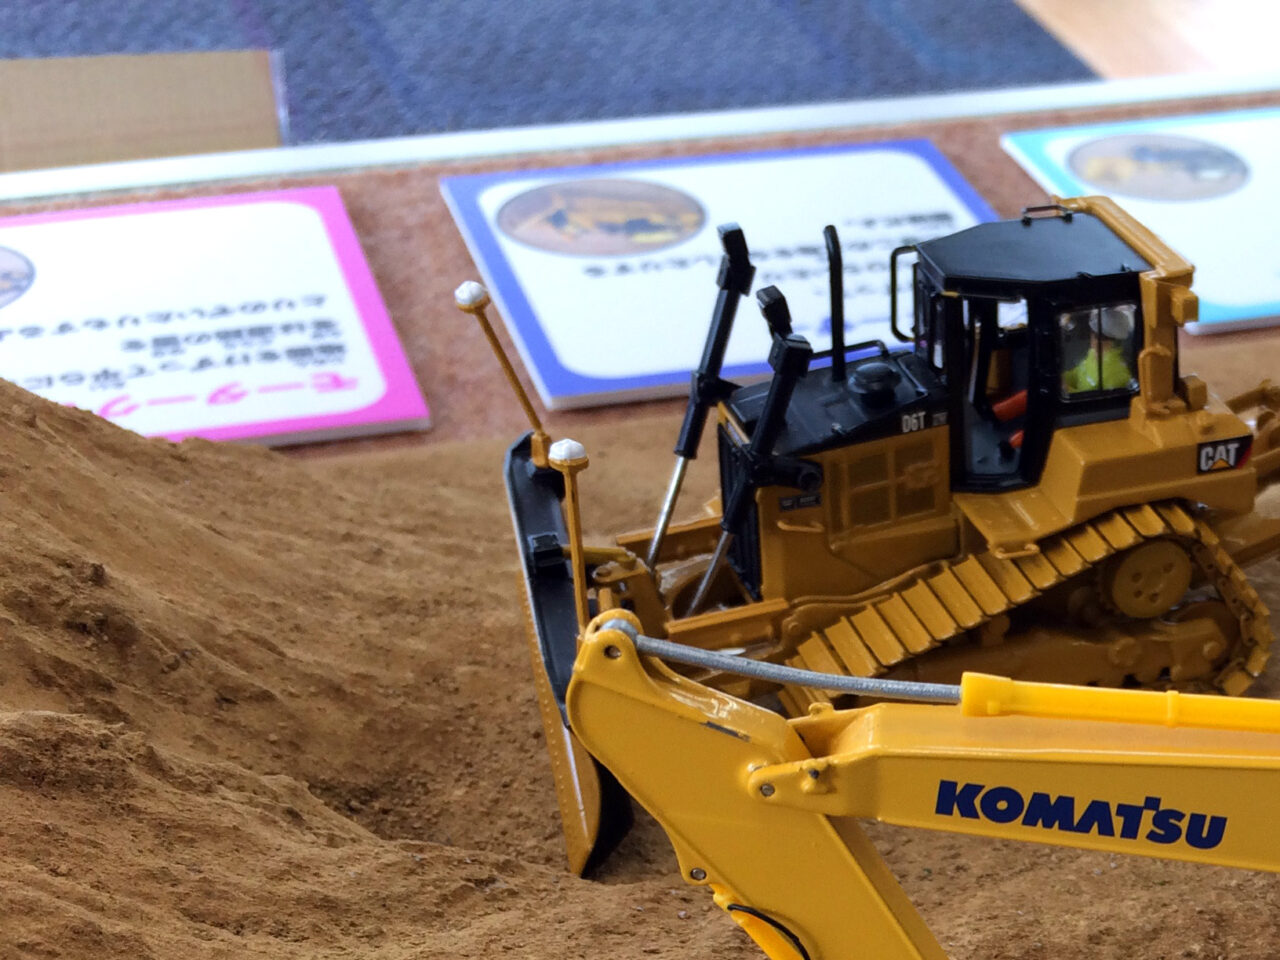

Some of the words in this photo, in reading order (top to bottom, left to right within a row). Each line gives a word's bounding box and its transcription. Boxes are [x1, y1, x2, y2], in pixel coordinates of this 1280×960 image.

[901, 411, 926, 433] D6T
[1200, 443, 1240, 472] CAT
[935, 779, 1228, 850] KOMATSU
